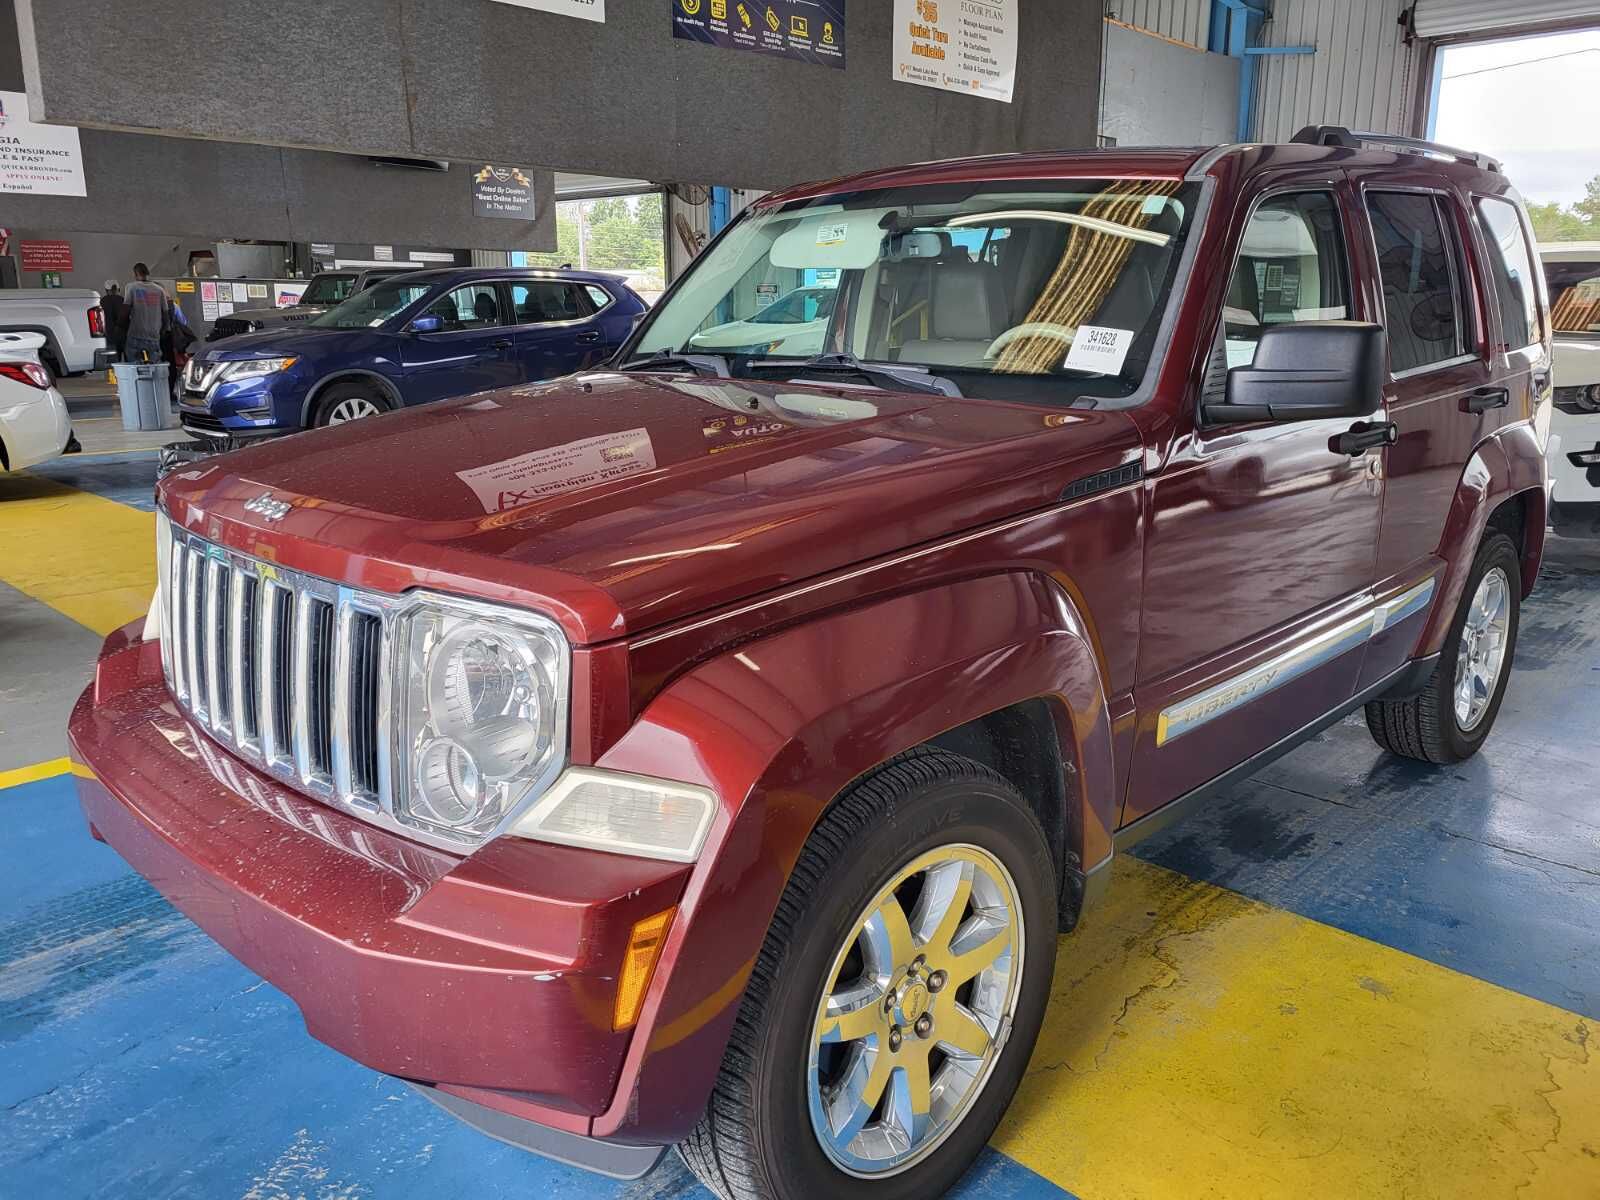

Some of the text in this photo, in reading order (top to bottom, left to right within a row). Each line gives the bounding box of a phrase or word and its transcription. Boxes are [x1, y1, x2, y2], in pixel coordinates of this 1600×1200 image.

[910, 22, 930, 40] Quick
[912, 40, 945, 60] Available
[14, 148, 71, 156] INSURANCE
[1088, 330, 1118, 346] 341628
[244, 491, 292, 522] Jeep
[1184, 669, 1279, 722] LIBERTY
